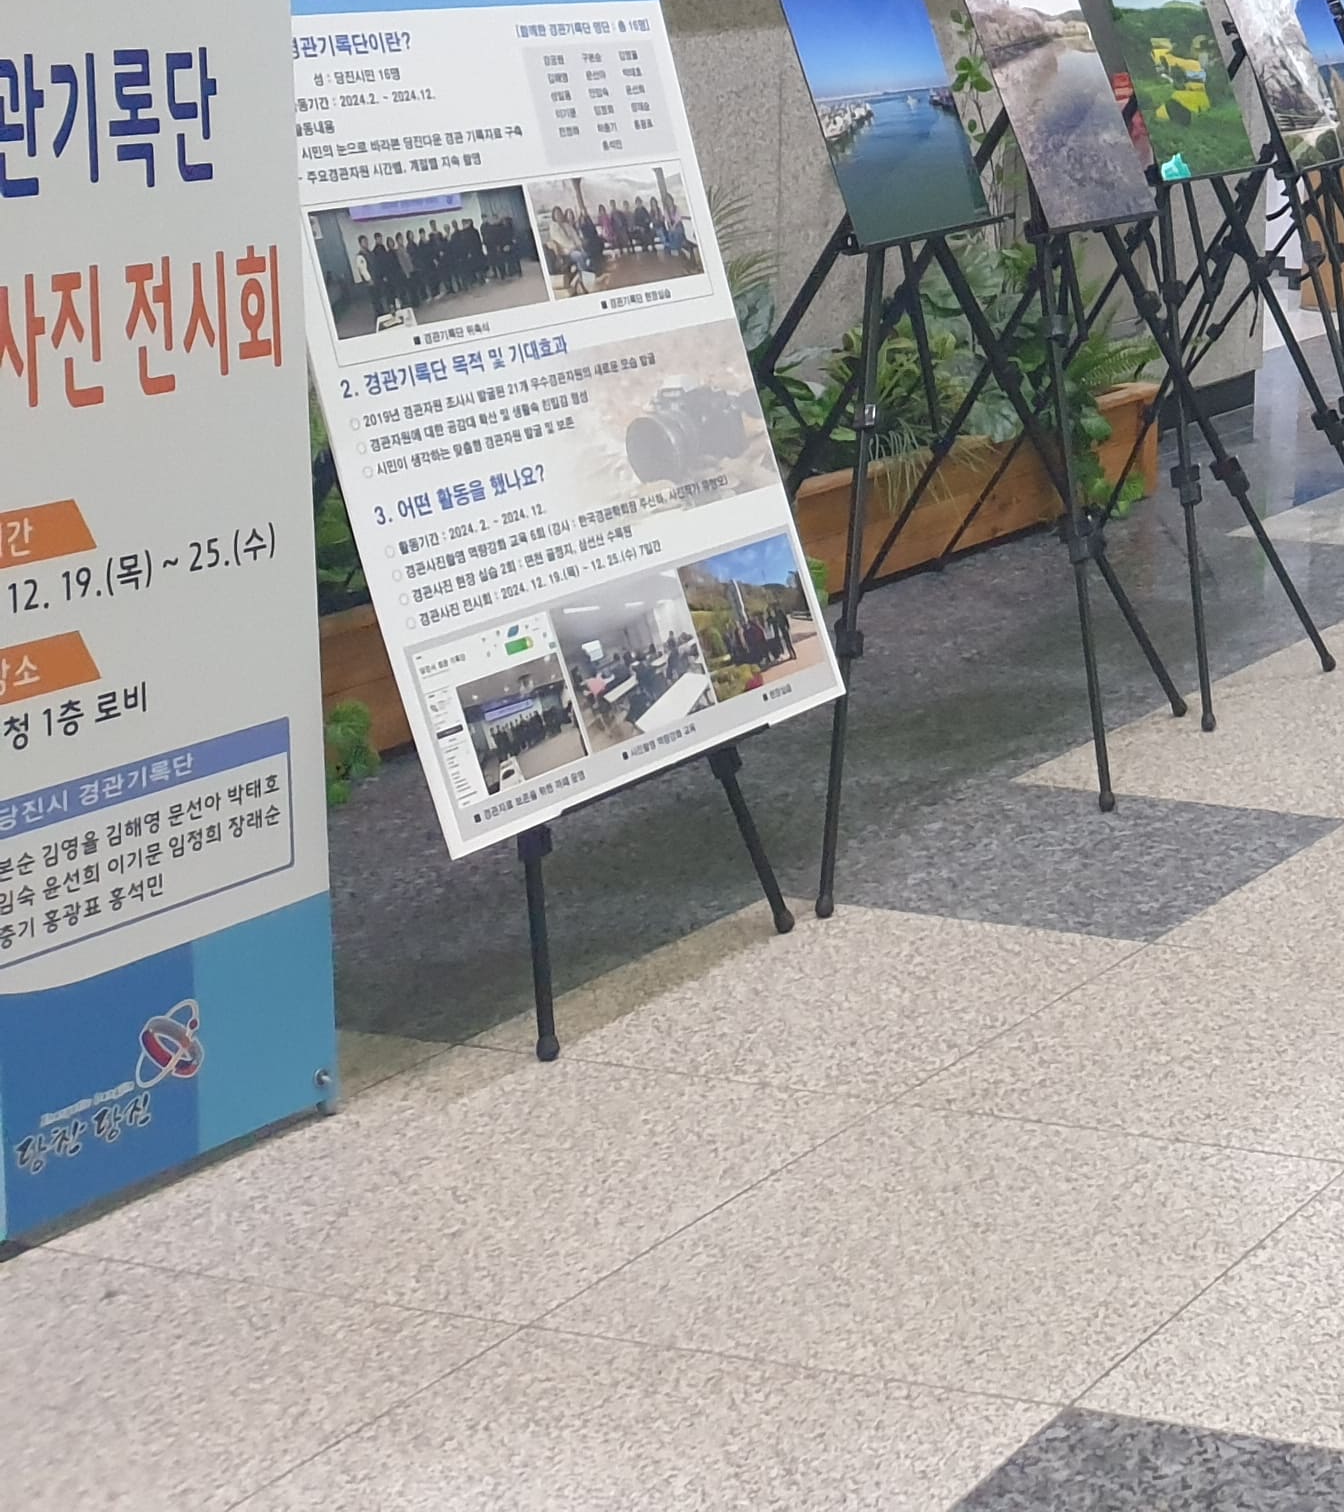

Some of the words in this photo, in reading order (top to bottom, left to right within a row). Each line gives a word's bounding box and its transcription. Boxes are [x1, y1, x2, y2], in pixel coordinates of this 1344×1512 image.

[295, 96, 329, 112] 동기간
[0, 260, 104, 408] 사진
[125, 244, 282, 396] 전시회
[364, 359, 448, 396] 경관기록단
[452, 350, 485, 375] 목적
[488, 347, 506, 370] 및
[508, 334, 568, 364] 기대효과
[397, 492, 433, 520] 어떤
[436, 479, 487, 511] 활동을
[0, 518, 33, 560] 간
[8, 579, 49, 613] 12.
[62, 549, 153, 601] 19.(목)
[189, 522, 276, 572] 25.(수)
[4, 713, 30, 750] 청
[42, 700, 84, 737] 1층
[95, 682, 148, 723] 로비
[79, 752, 195, 807] 경관기록단
[107, 811, 161, 848] 김해영
[168, 796, 222, 828] 문선아
[227, 773, 281, 805] 박태호
[42, 864, 100, 900] 윤선희
[108, 842, 163, 876] 이기문
[169, 823, 222, 858] 임정희
[43, 897, 101, 934] 홍광표
[109, 874, 164, 912] 홍석민
